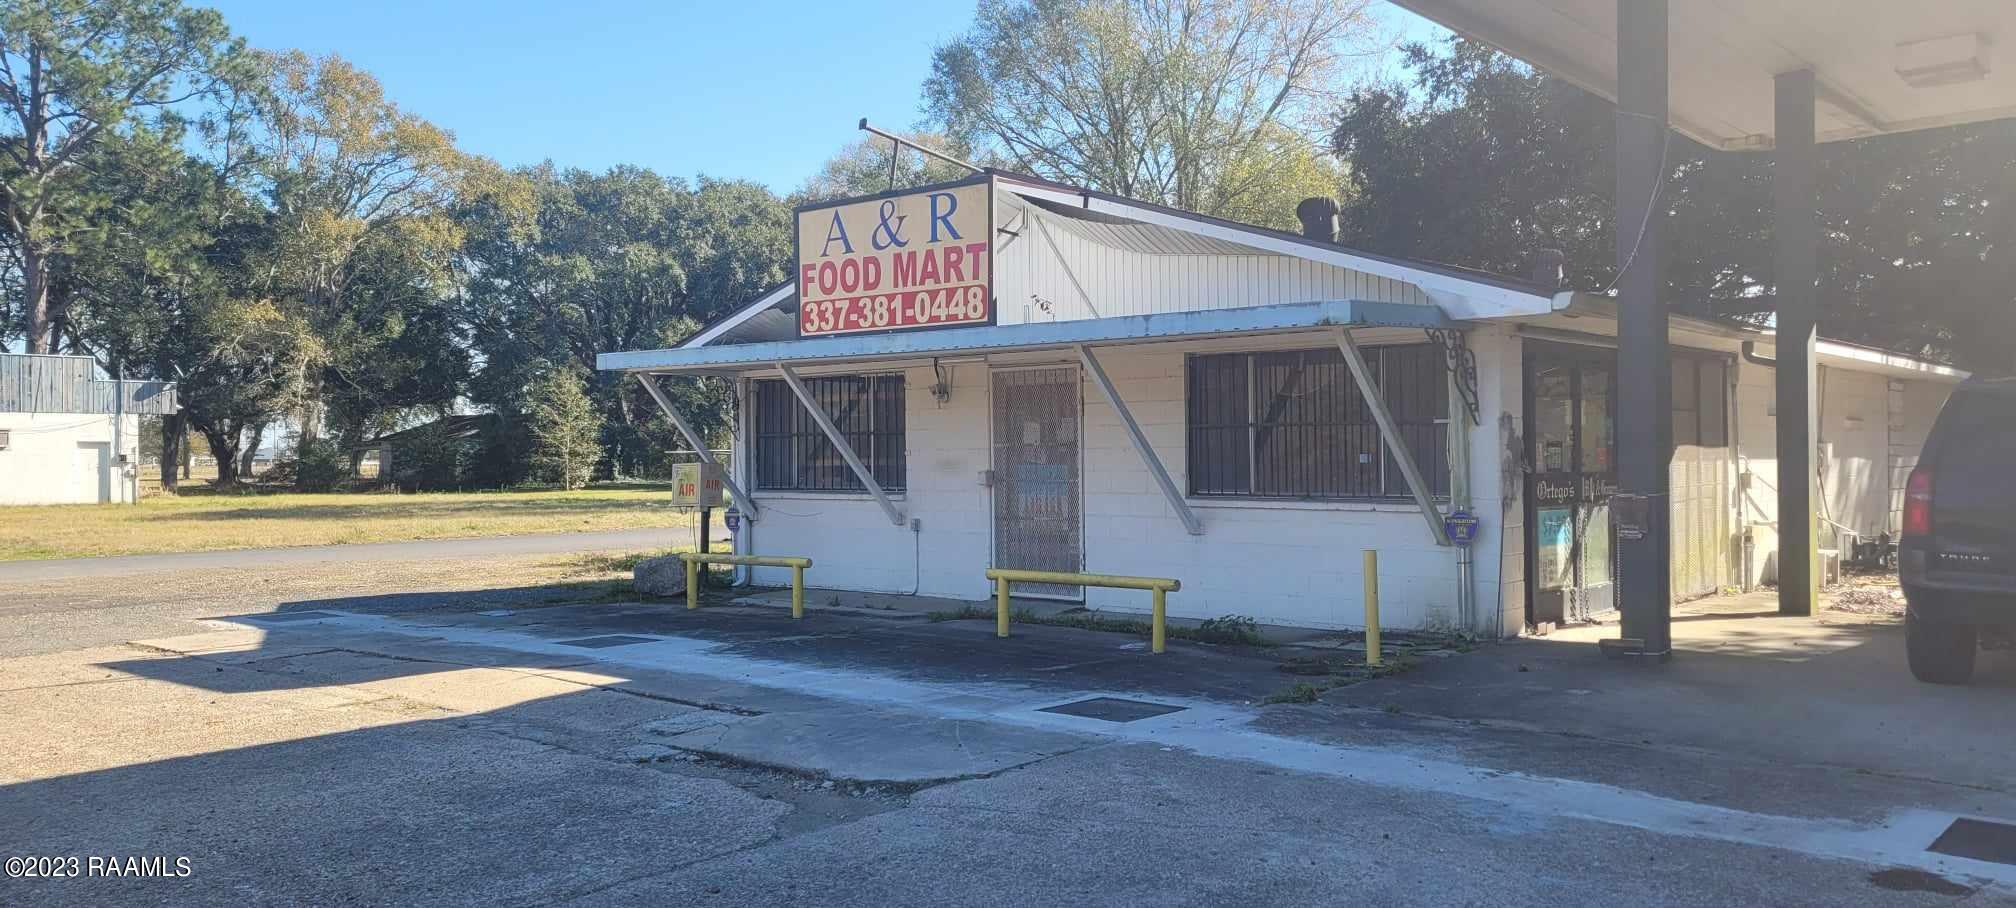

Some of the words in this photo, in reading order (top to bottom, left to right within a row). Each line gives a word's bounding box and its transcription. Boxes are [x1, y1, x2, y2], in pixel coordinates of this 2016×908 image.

[820, 209, 855, 257] A
[872, 200, 910, 250] &
[926, 192, 964, 243] R
[802, 255, 882, 297] FOOD
[892, 242, 987, 288] MART
[804, 286, 984, 332] 337-381-0448
[678, 483, 695, 496] AIR
[705, 480, 720, 491] AIR
[1537, 480, 1575, 503] Ortego's
